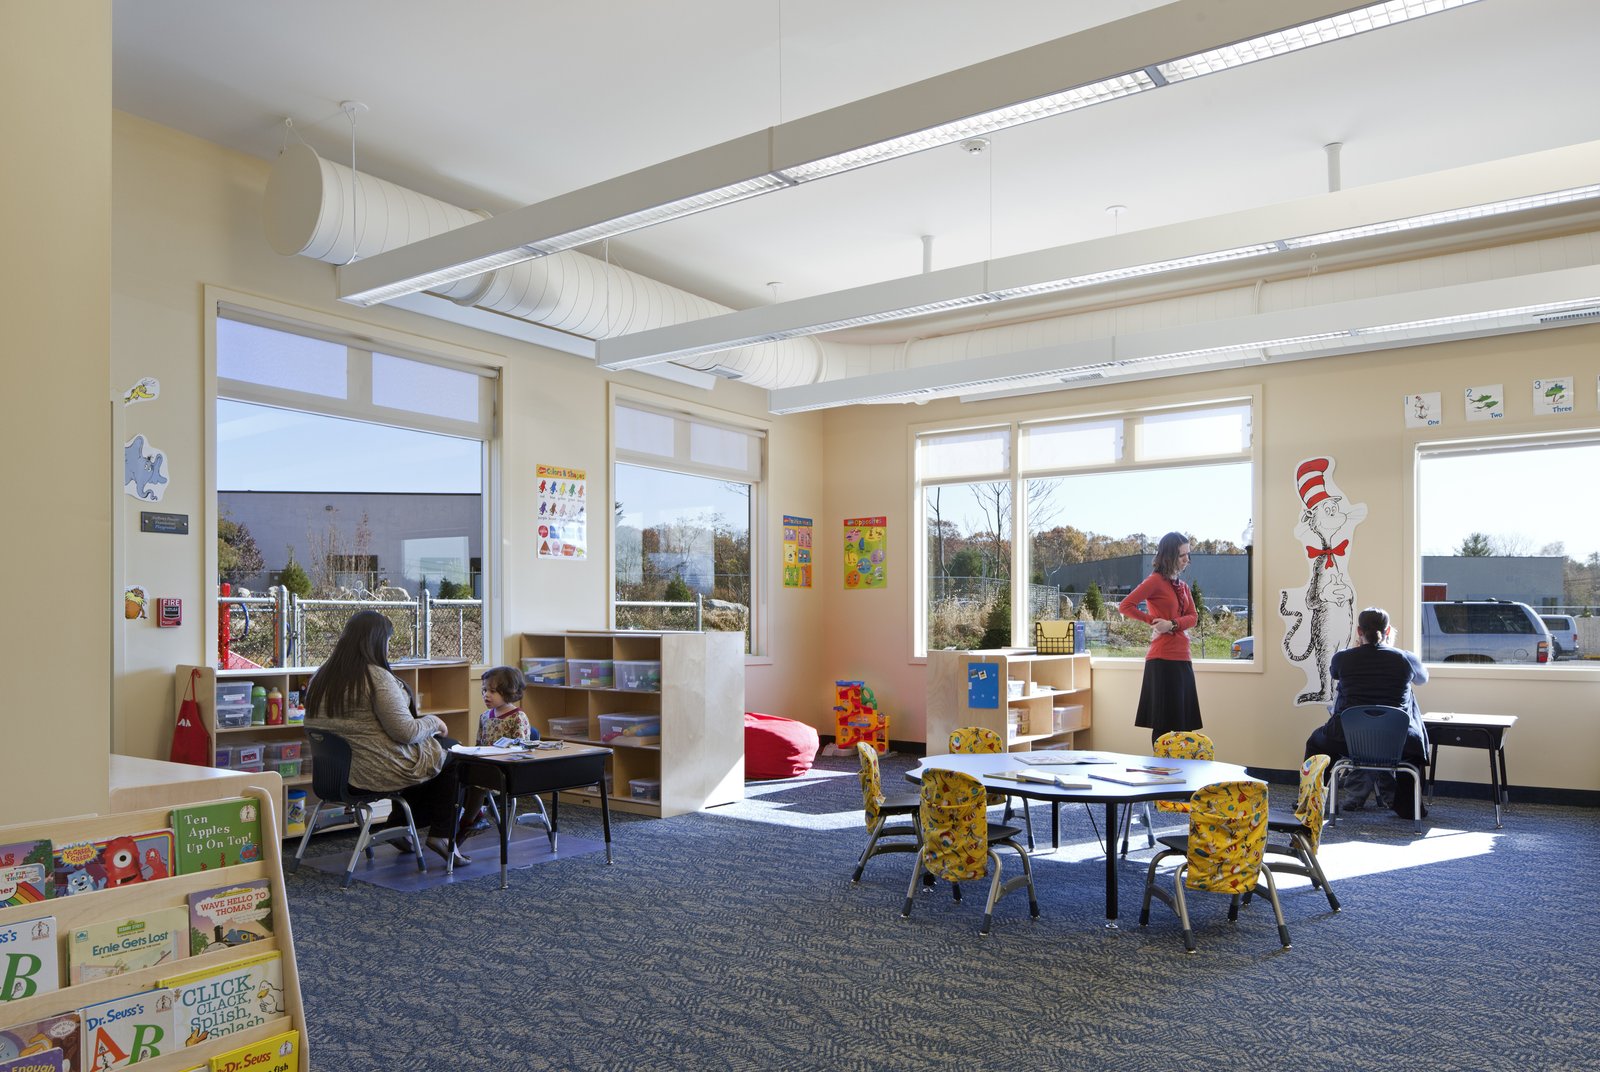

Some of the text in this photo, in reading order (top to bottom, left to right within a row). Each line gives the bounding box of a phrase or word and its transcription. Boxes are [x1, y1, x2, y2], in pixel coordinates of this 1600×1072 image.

[1466, 388, 1473, 397] 2
[1534, 380, 1541, 389] 3
[854, 517, 882, 526] Opposites
[184, 814, 208, 825] Ten
[189, 825, 230, 839] Apples
[186, 832, 252, 854] Up On Top!
[200, 900, 225, 912] WAVE
[226, 894, 253, 907] HELLO
[254, 891, 267, 901] TO
[215, 902, 253, 916] THOMAS!
[92, 942, 120, 957] Ernie
[122, 936, 147, 949] Gets
[148, 931, 169, 944] Lost
[182, 974, 256, 1007] CLICK,
[196, 992, 252, 1016] CLACK,
[86, 1016, 107, 1032] Dr.
[107, 1003, 144, 1023] Seuss's
[190, 1006, 252, 1034] Splish,
[225, 1051, 272, 1072] Dr. Seuss
